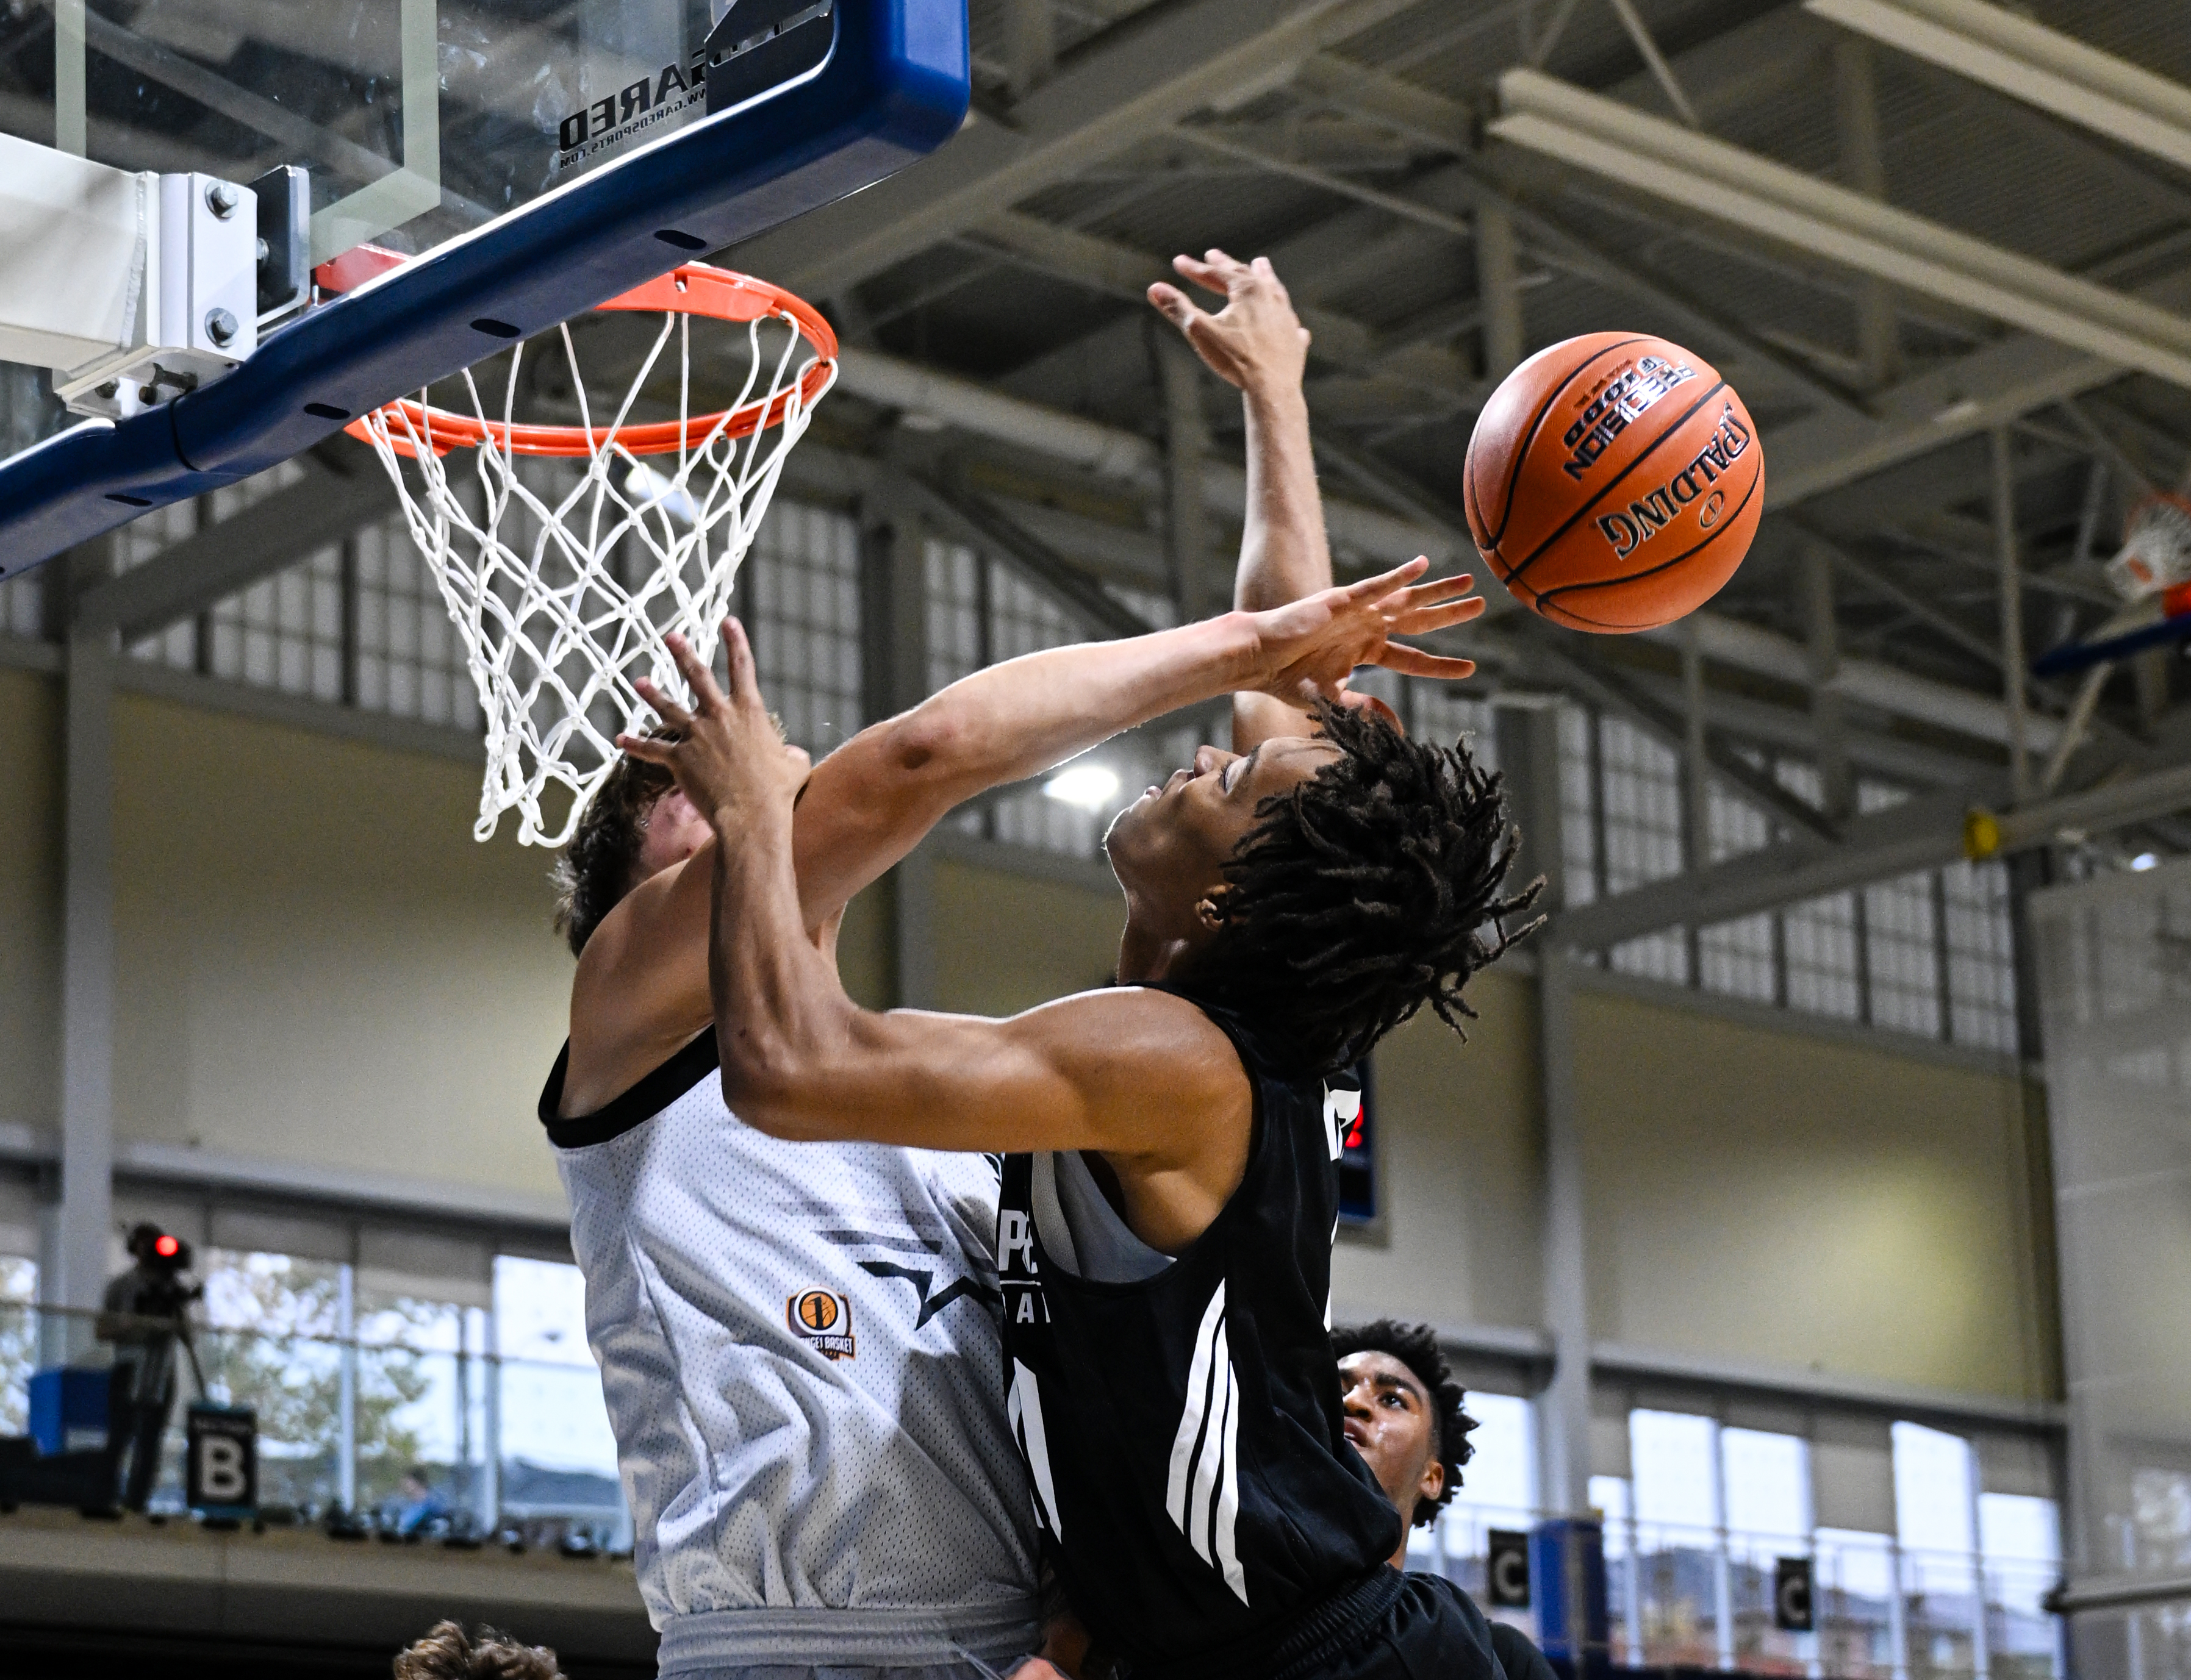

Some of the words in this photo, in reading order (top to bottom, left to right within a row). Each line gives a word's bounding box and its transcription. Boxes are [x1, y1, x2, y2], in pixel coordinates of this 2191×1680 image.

[1563, 368, 1641, 449] 1000
[1563, 360, 1698, 482] PRECISION
[1596, 400, 1750, 561] SPALDING
[825, 1336, 852, 1354] BASKET
[201, 1435, 246, 1498] B
